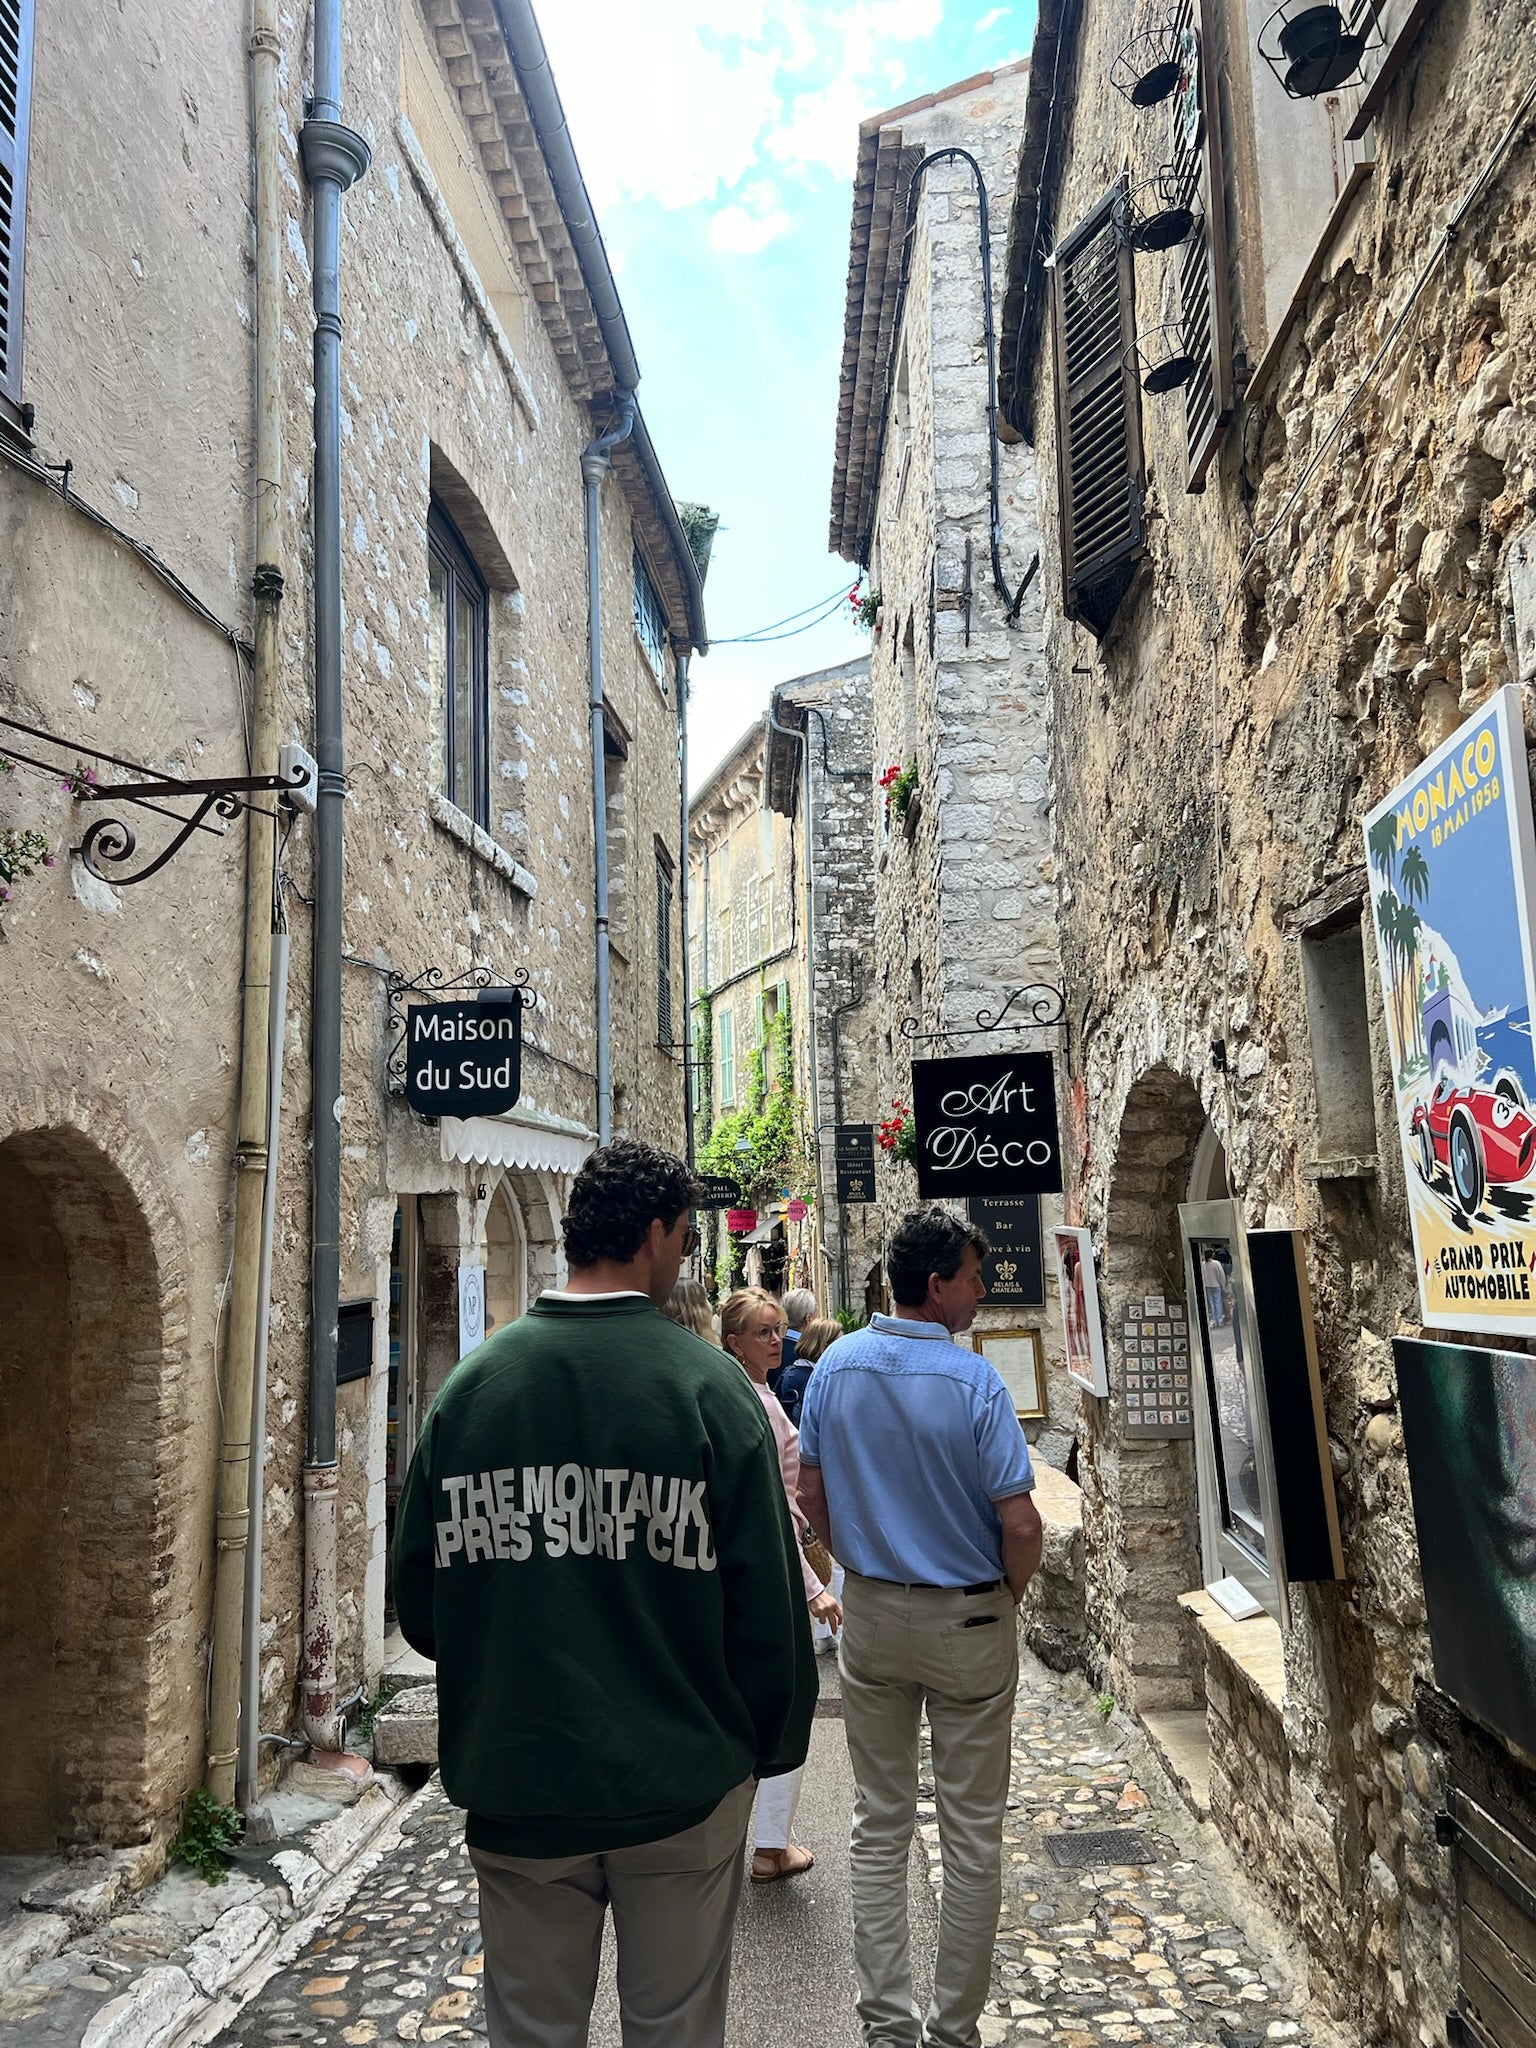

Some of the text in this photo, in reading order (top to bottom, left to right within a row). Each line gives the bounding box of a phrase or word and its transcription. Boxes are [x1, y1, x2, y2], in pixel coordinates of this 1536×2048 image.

[1396, 729, 1495, 851] MONACO
[1431, 776, 1500, 848] 18 MAI 1958
[414, 1012, 513, 1042] Maison
[416, 1057, 511, 1091] du Sud
[941, 1071, 1035, 1117] Art
[926, 1126, 1051, 1171] Déco
[982, 1198, 1025, 1207] Terrasse
[995, 1221, 1013, 1230] Bar
[1006, 1243, 1012, 1253] à
[1015, 1244, 1031, 1253] vin
[1440, 1245, 1483, 1271] GRAND
[1490, 1241, 1526, 1269] PRIX
[1445, 1273, 1530, 1300] AUTOMOBILE
[442, 1462, 706, 1528] THE MONTAUK
[543, 1507, 635, 1560] SURF
